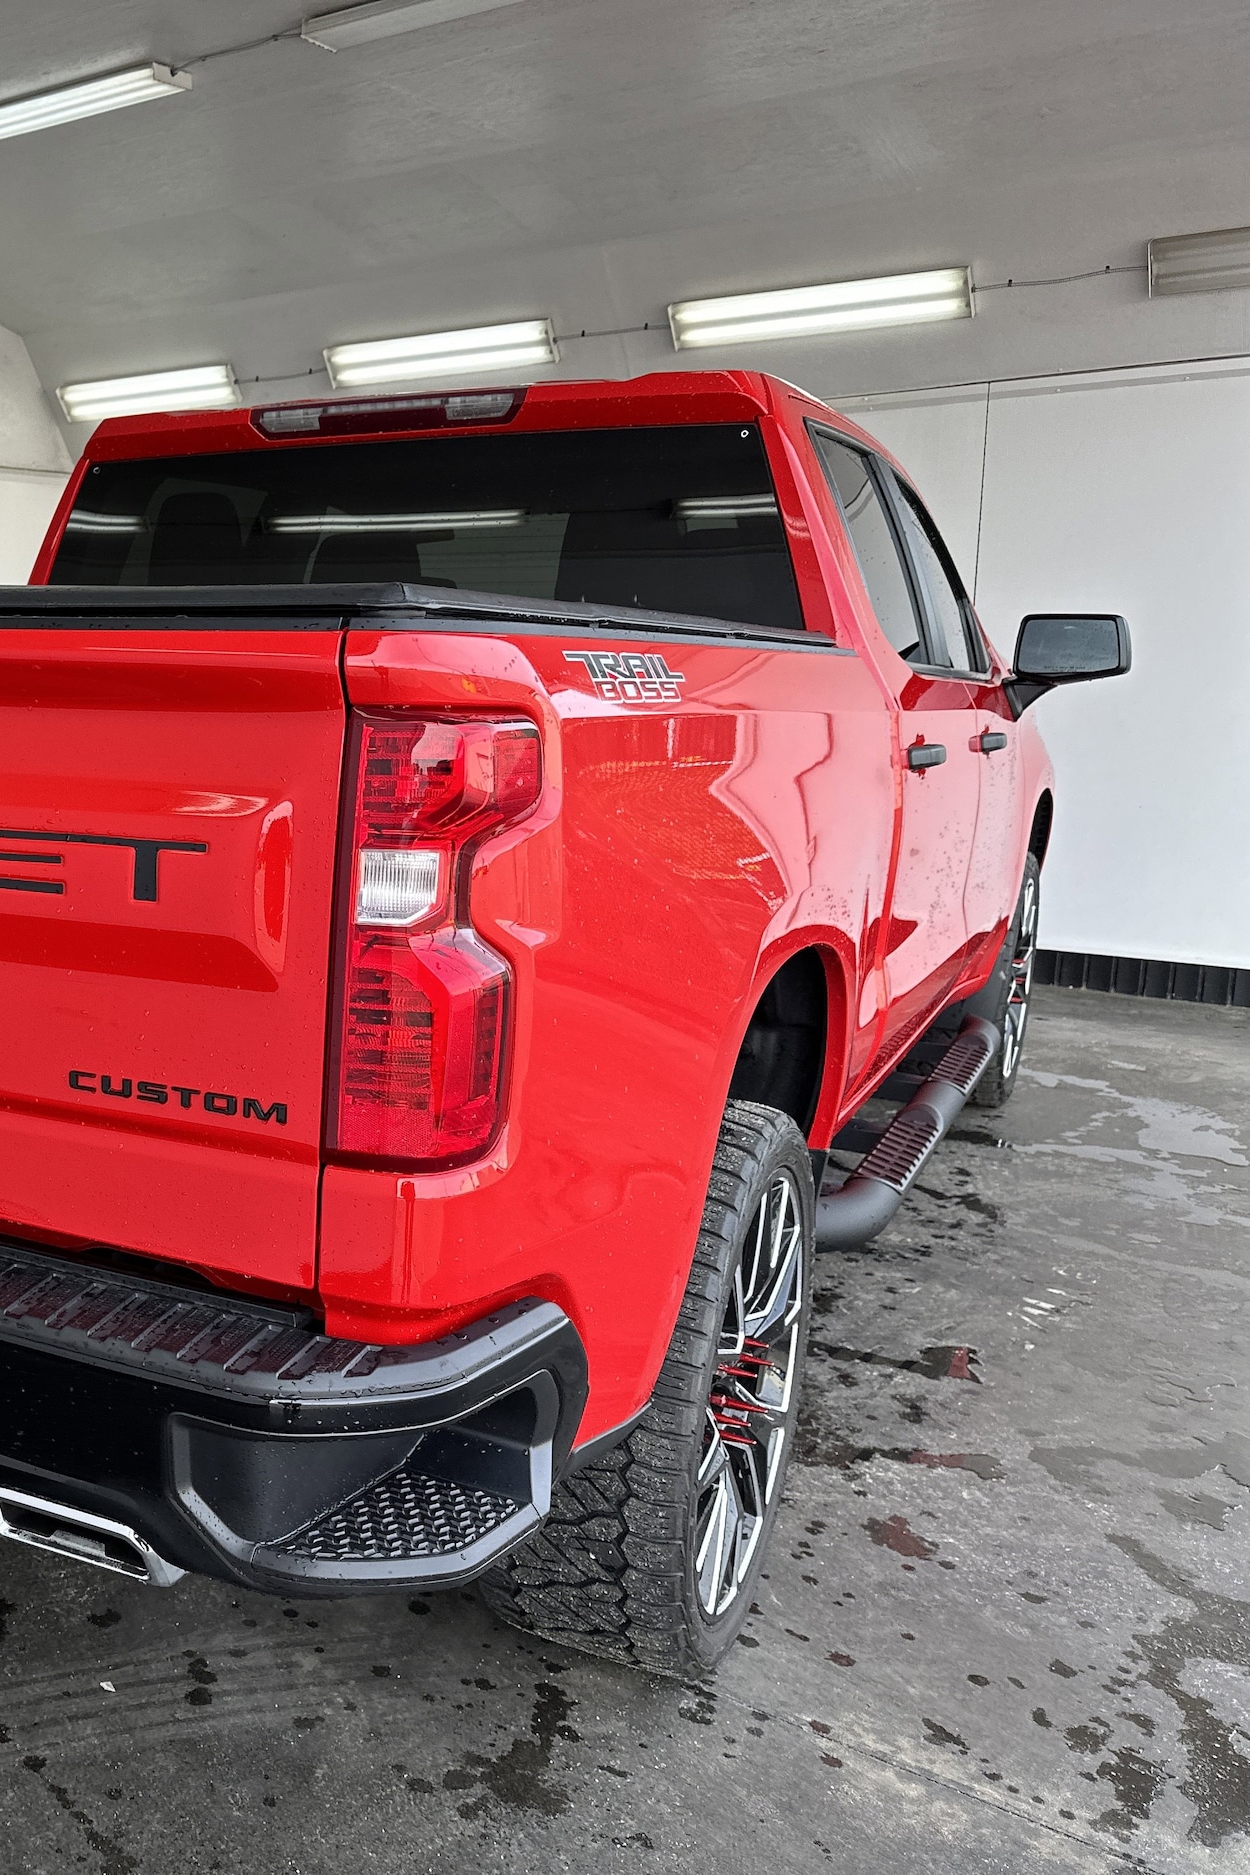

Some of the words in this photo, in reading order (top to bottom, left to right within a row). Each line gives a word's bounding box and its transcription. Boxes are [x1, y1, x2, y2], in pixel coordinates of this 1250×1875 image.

[562, 650, 686, 682] TRAIL
[593, 680, 682, 704] BOSS
[68, 1070, 288, 1126] CUSTOM
